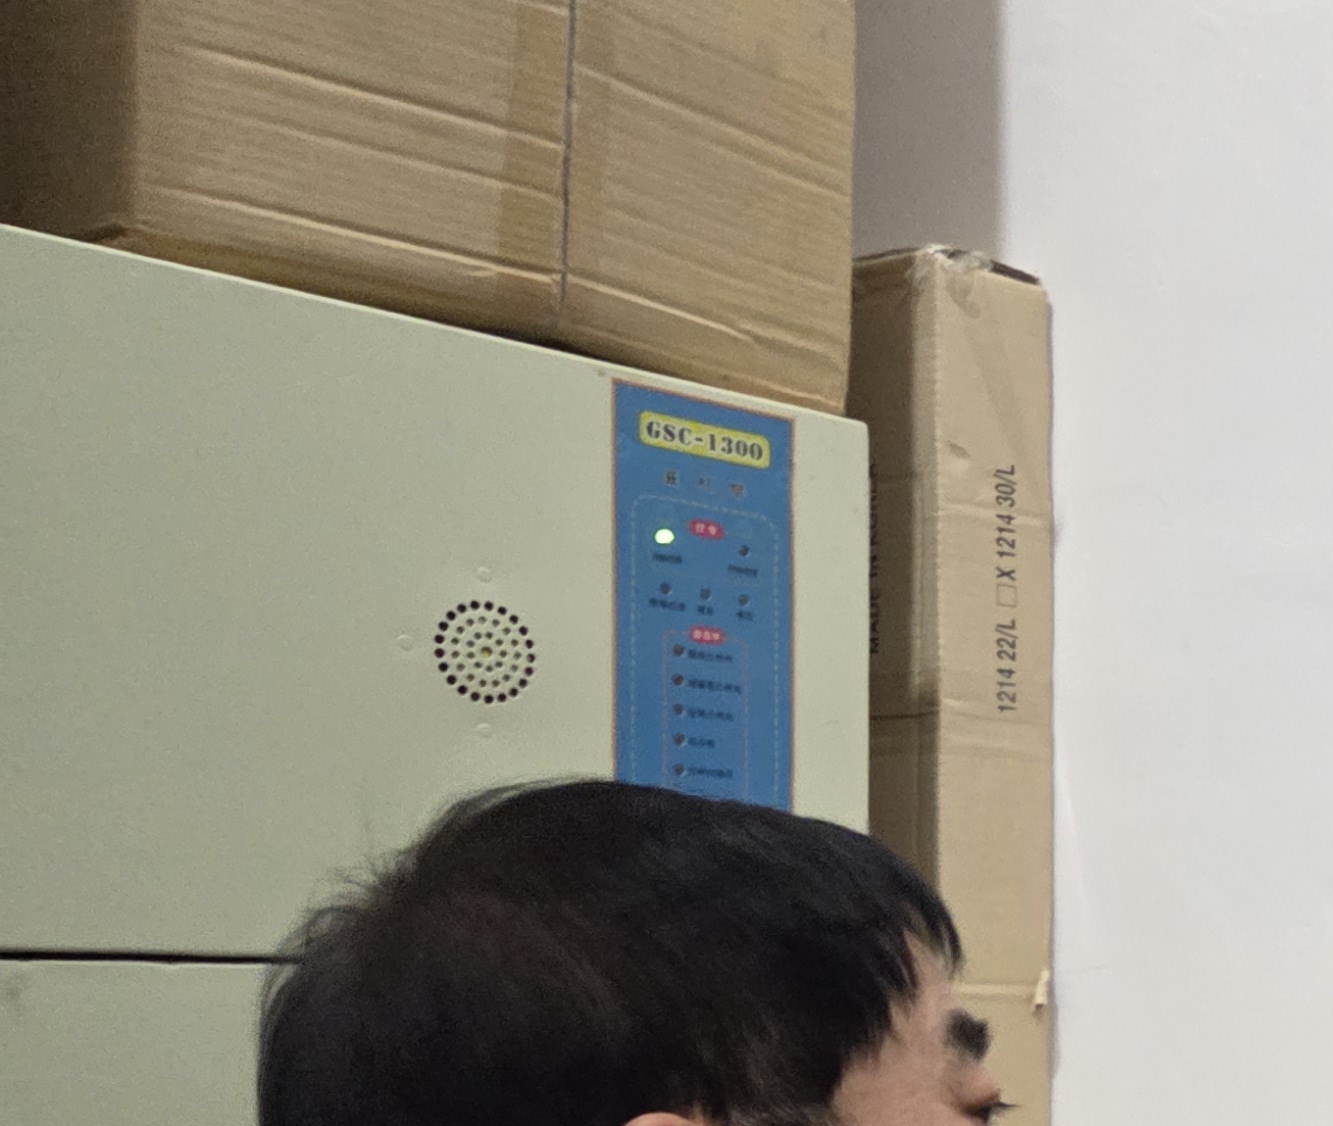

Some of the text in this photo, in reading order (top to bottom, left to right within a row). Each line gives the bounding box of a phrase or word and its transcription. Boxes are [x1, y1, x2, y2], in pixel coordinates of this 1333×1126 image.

[646, 420, 764, 462] GSC-1300
[993, 464, 1018, 508] 30/L
[996, 513, 1017, 558] 1214
[995, 618, 1018, 662] 22/L
[997, 668, 1017, 713] 1214
